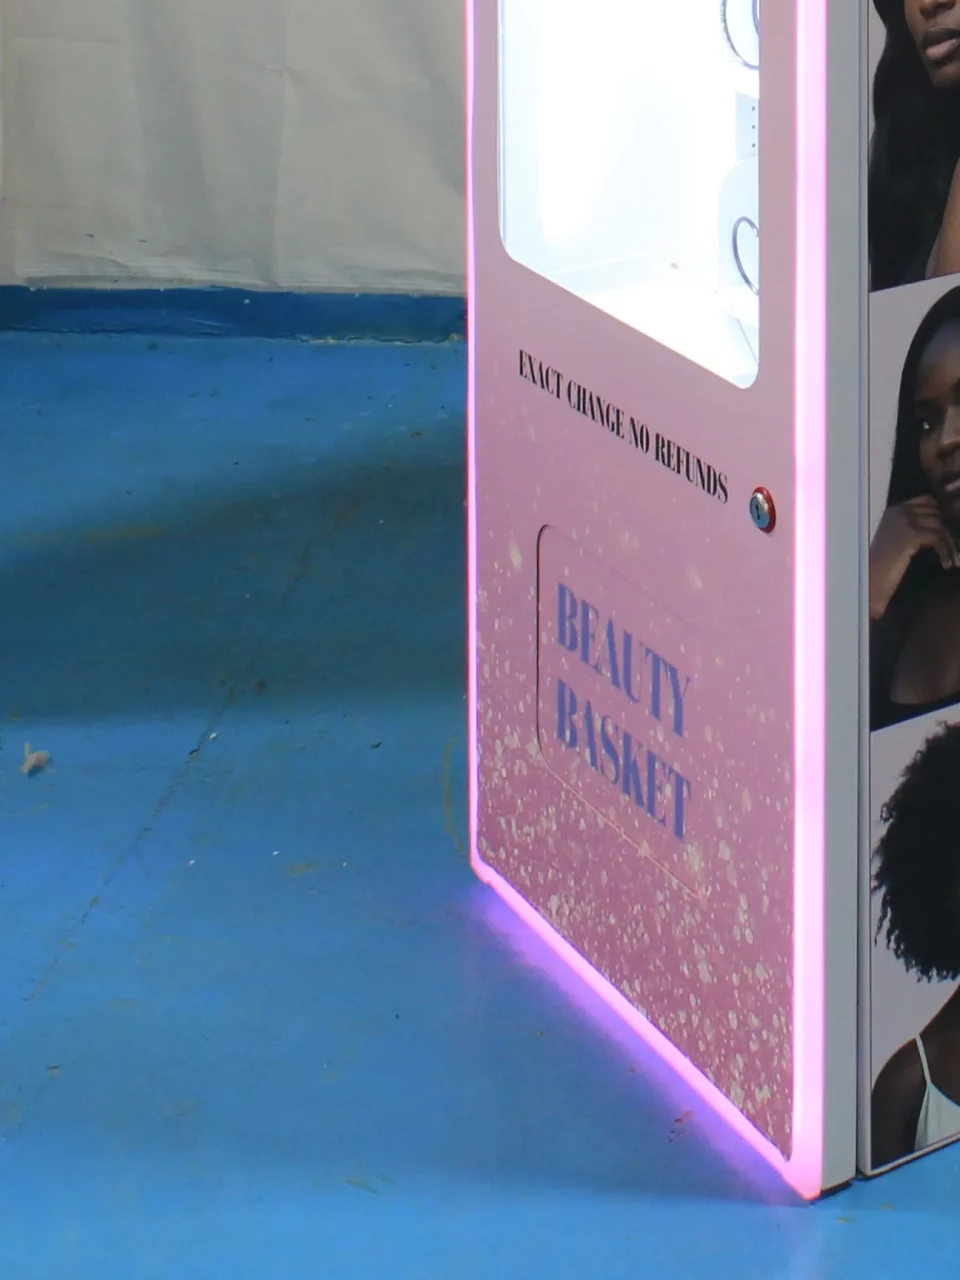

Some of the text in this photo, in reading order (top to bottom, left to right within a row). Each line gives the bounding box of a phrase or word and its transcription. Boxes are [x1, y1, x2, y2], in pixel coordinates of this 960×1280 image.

[519, 349, 728, 505] EXACT CHANGE NO REFUNDS
[557, 582, 691, 738] BEAUTY
[556, 678, 691, 841] BASKET
